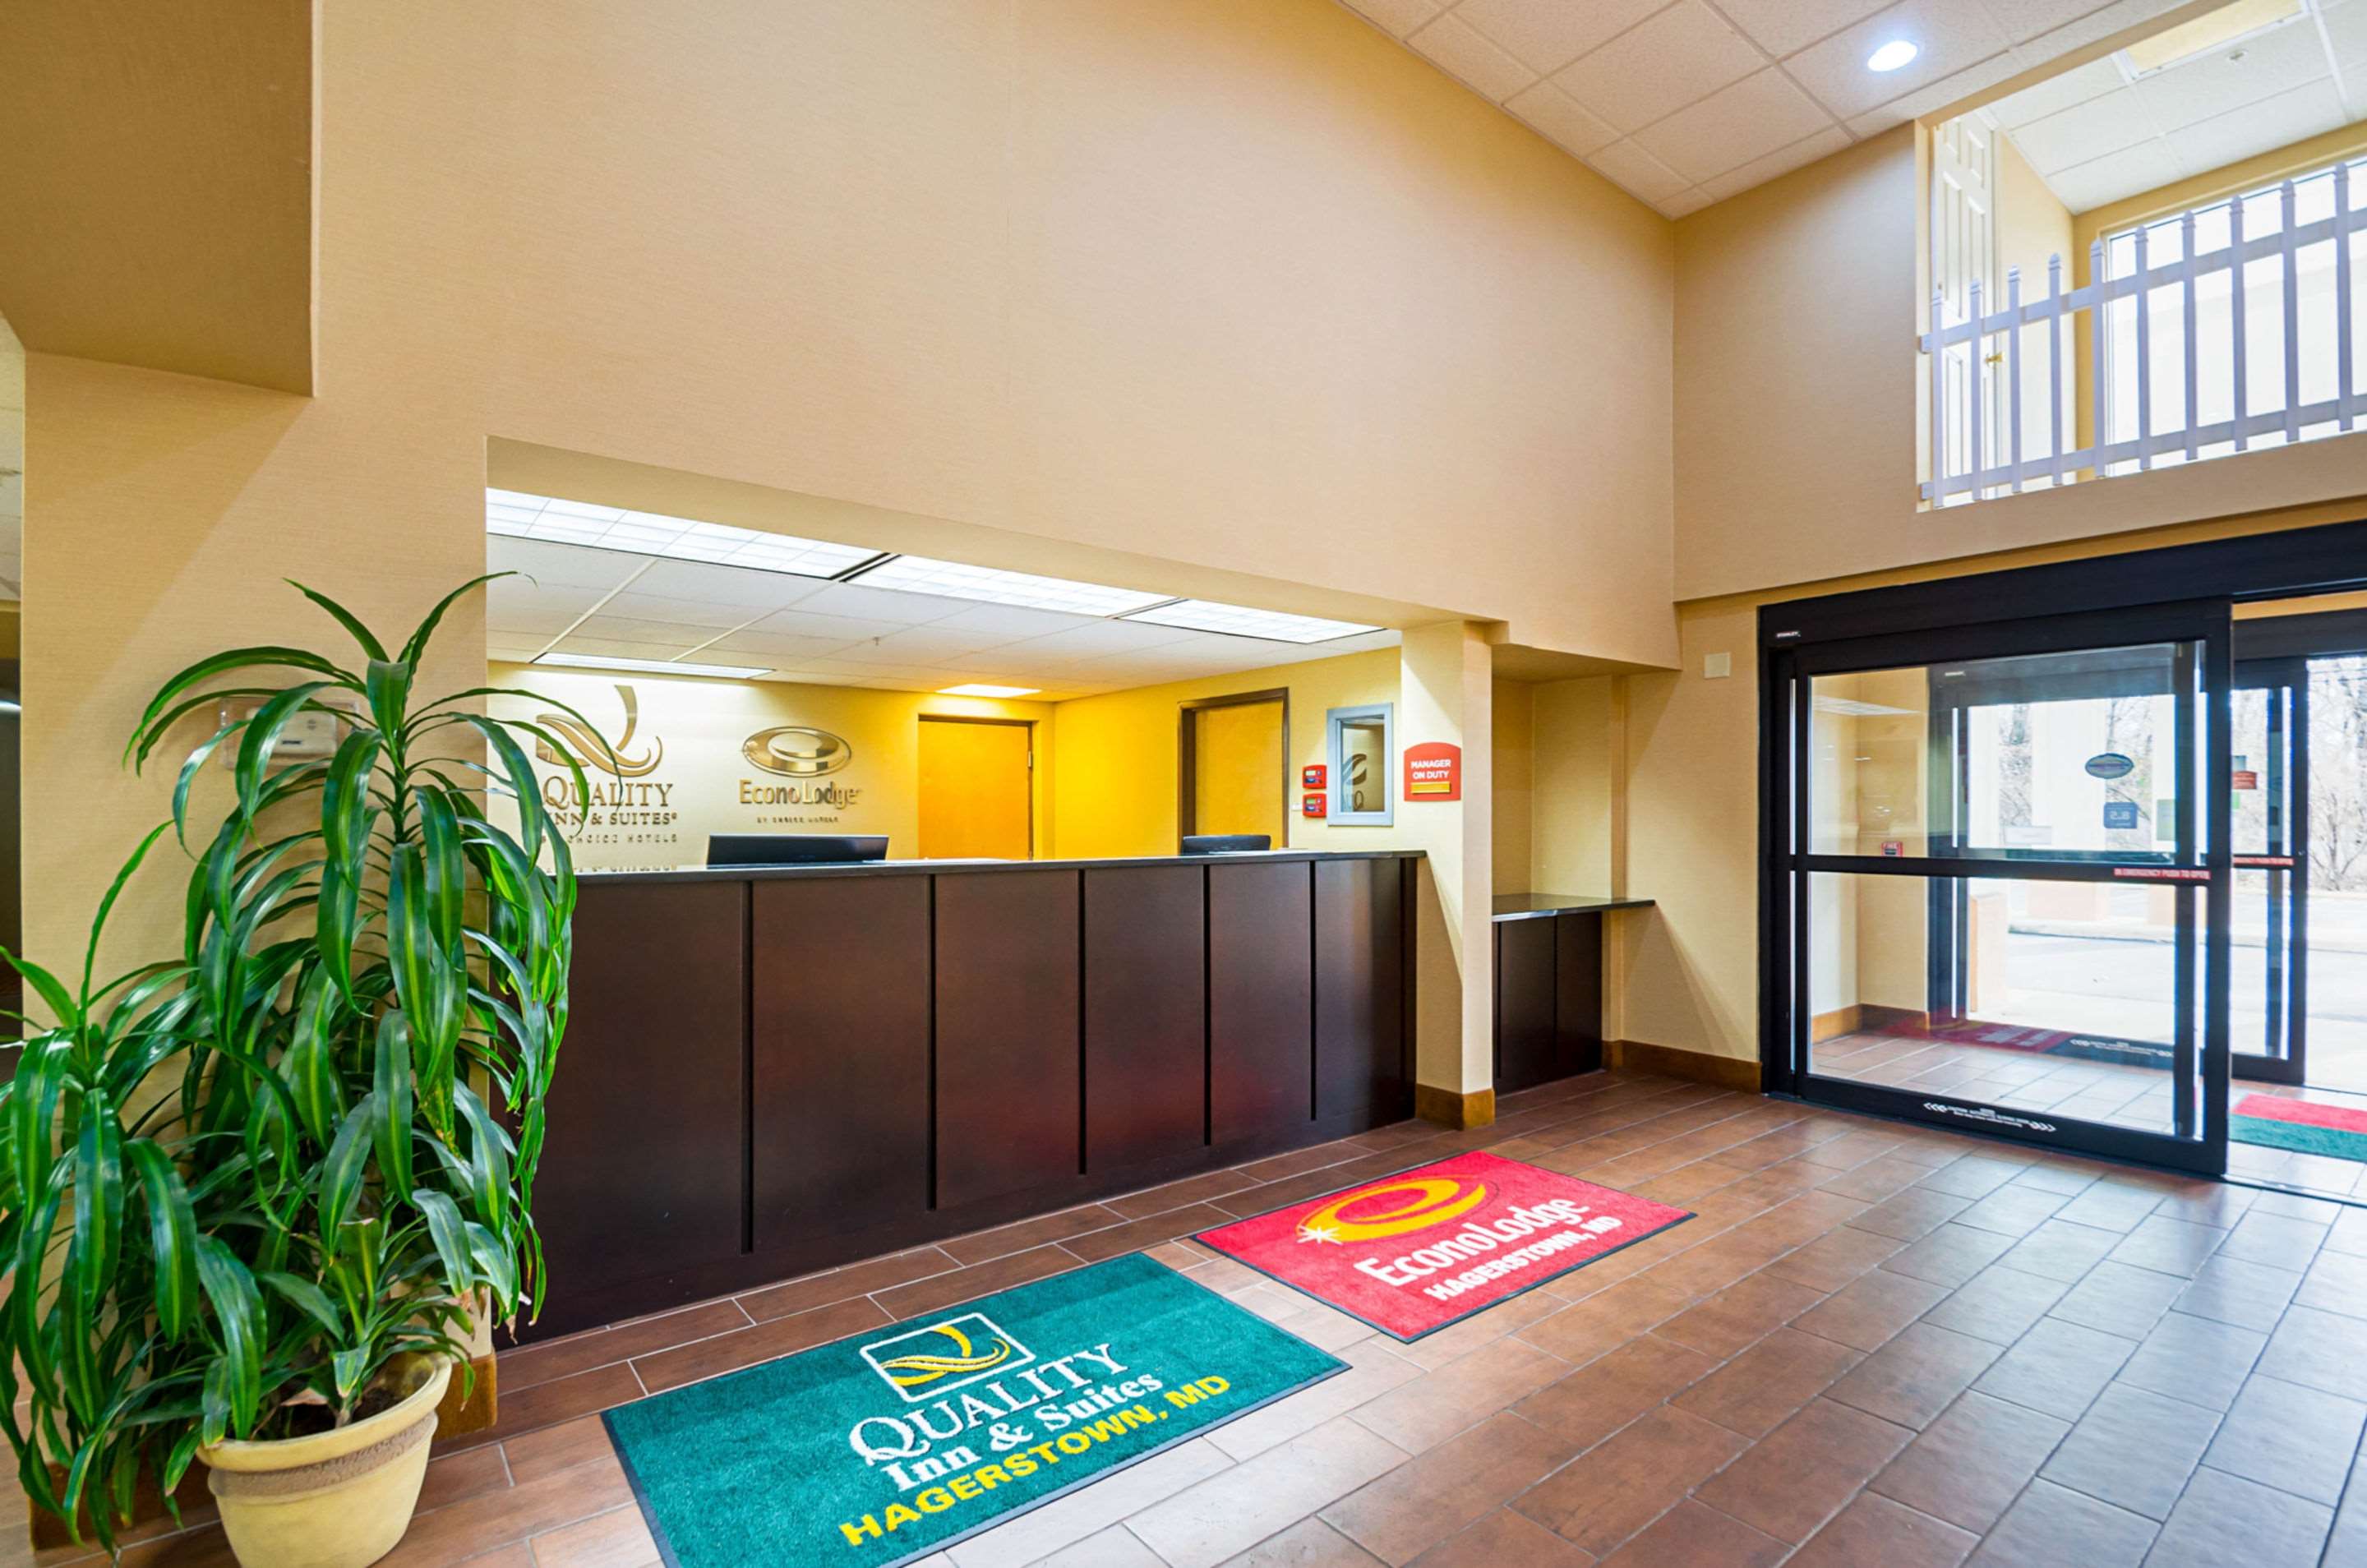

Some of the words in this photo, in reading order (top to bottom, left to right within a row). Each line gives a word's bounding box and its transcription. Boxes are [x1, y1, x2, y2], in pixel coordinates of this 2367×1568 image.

[1410, 759, 1451, 769] MANAGER
[1413, 772, 1425, 780] ON
[1426, 770, 1450, 779] DUTY
[547, 812, 584, 825] NN
[591, 812, 602, 825] &
[1353, 1198, 1591, 1287] EconoLodge
[1423, 1229, 1598, 1301] HAGERSTOWN,
[1579, 1215, 1623, 1234] MD
[849, 1343, 1130, 1467] QUALITY
[881, 1446, 981, 1492] Inn
[989, 1422, 1034, 1452] &
[1034, 1373, 1163, 1432] Suites
[839, 1404, 1168, 1547] HAGERSTOWN,
[1164, 1375, 1231, 1409] MD
